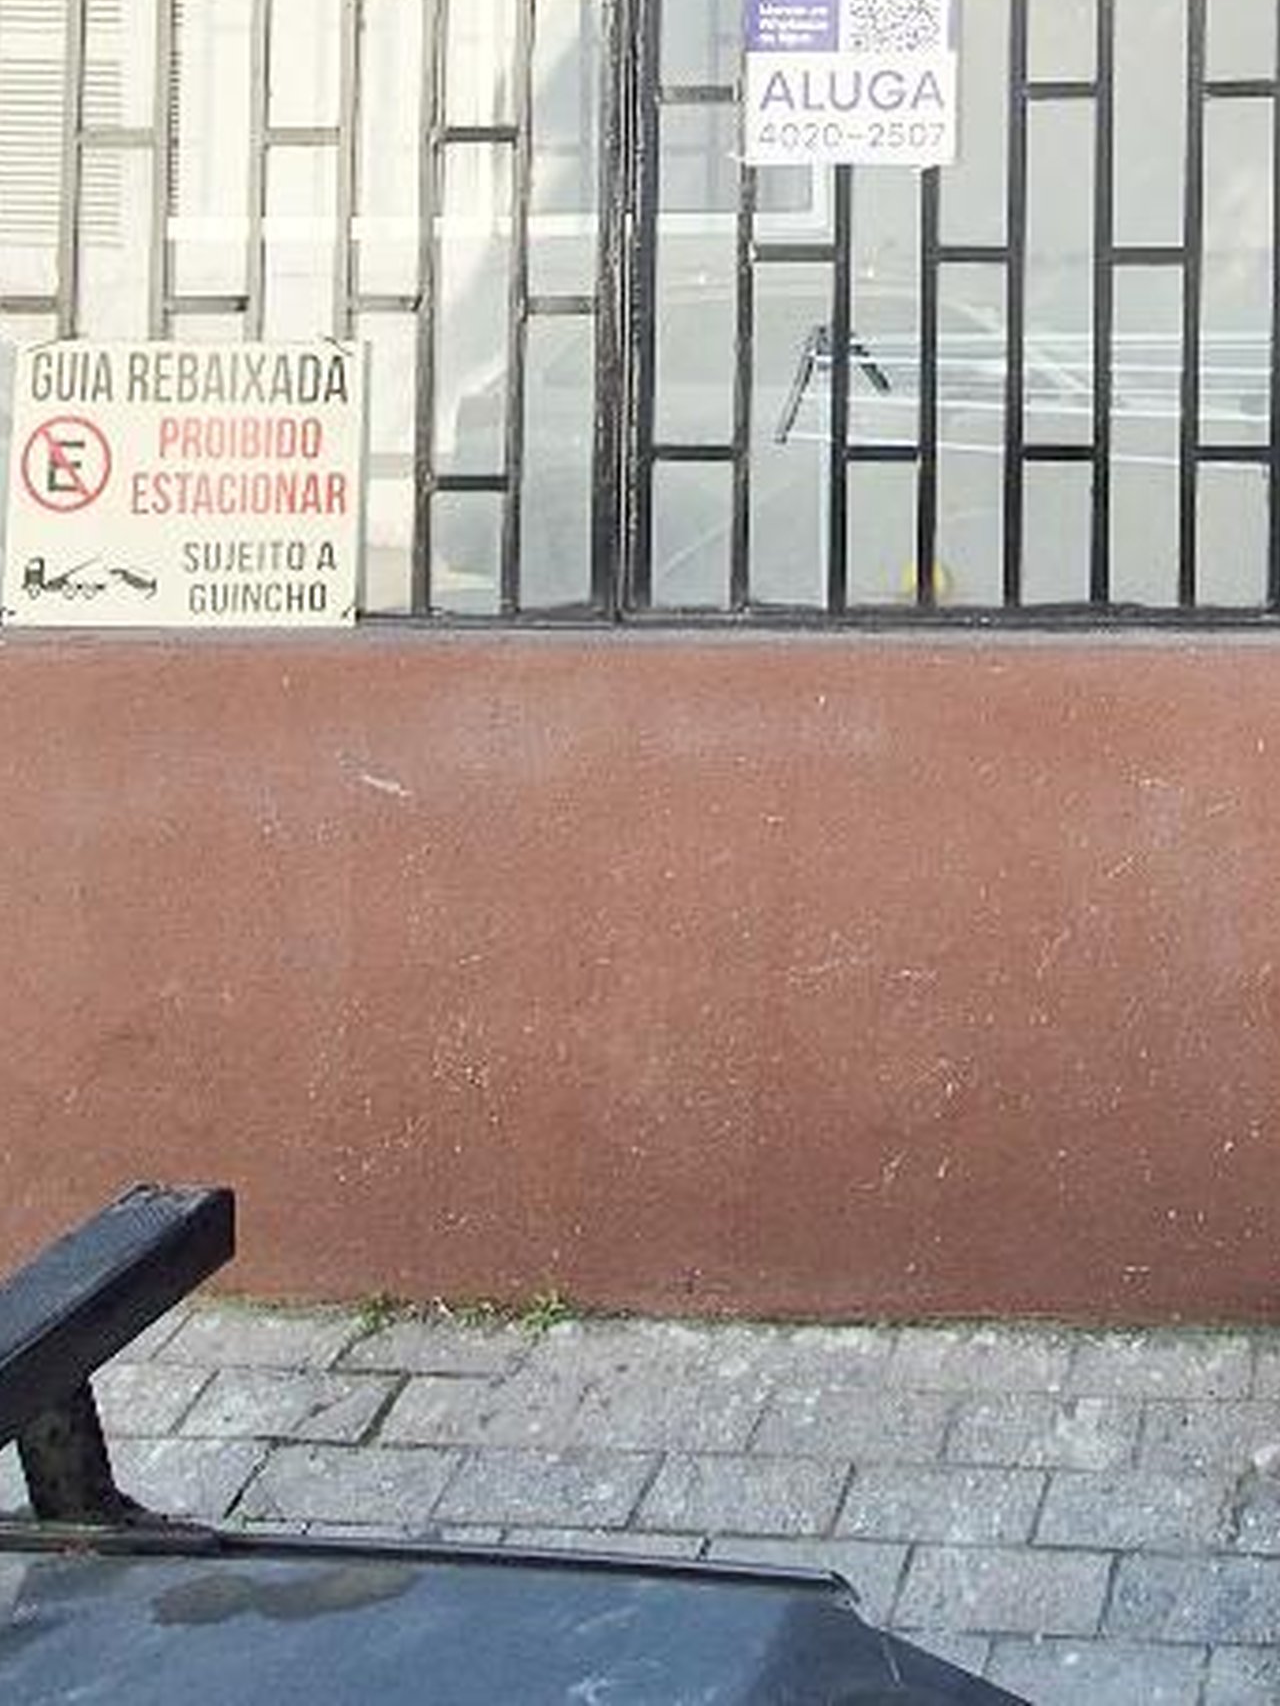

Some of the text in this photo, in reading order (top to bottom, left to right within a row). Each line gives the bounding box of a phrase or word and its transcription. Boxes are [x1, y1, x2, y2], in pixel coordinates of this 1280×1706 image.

[759, 70, 945, 111] ALUGA
[758, 122, 946, 148] 4020-2507
[31, 351, 348, 404] GUIA REBAIXADA
[159, 417, 323, 458] PROIBIDO
[131, 471, 347, 515] ESTACIONAR
[184, 540, 337, 572] SUJEITO A
[188, 583, 327, 613] GUINCHO
